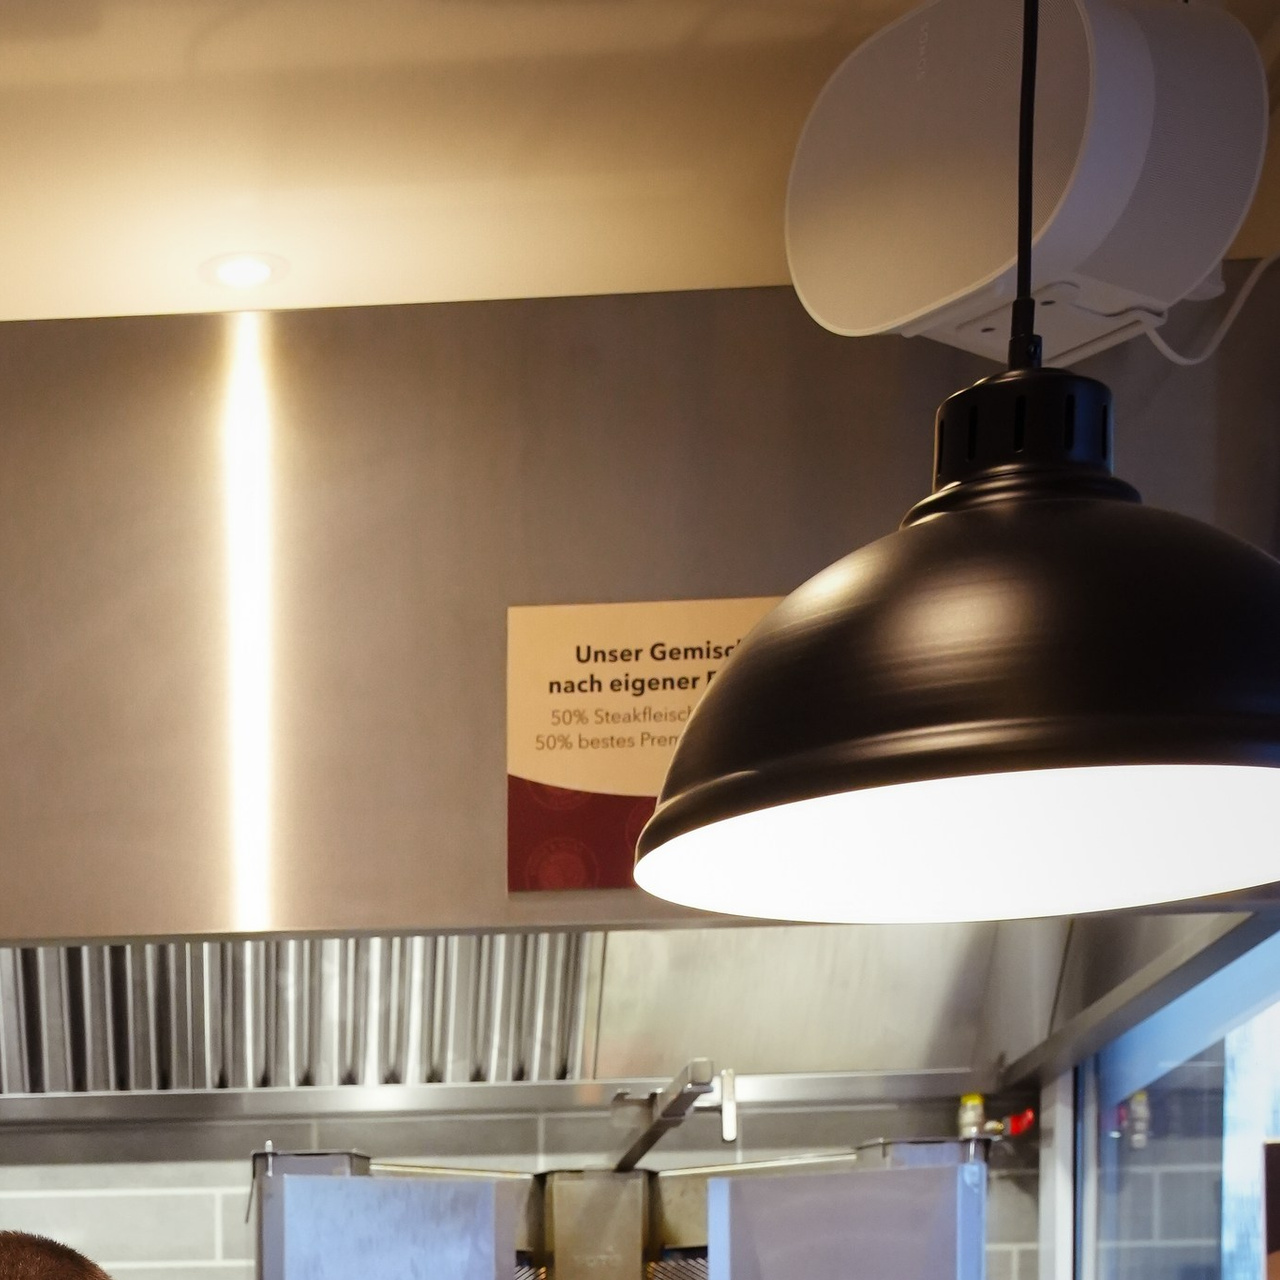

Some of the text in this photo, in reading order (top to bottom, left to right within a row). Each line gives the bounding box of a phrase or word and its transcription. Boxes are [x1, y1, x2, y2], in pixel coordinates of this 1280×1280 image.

[575, 639, 741, 664] Unser Gemisc
[548, 673, 602, 694] nach
[609, 672, 700, 697] eigener
[551, 708, 589, 727] 50%
[535, 733, 573, 751] 50%
[578, 731, 635, 750] bestes
